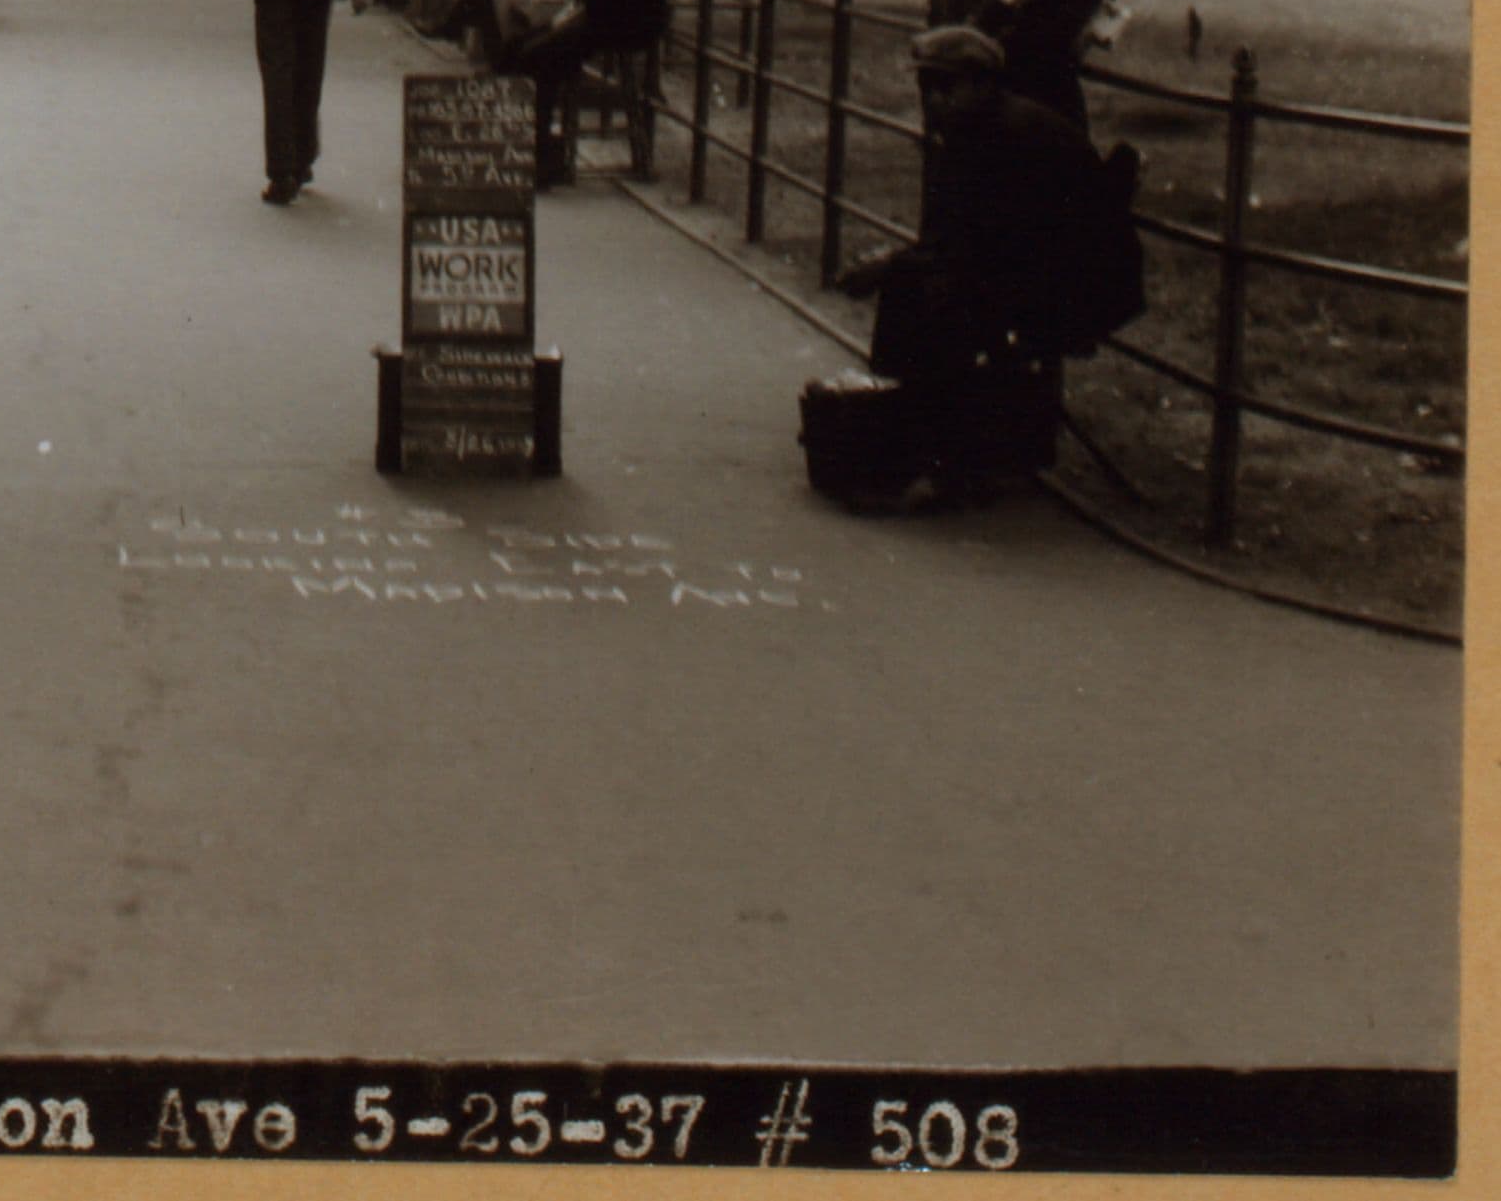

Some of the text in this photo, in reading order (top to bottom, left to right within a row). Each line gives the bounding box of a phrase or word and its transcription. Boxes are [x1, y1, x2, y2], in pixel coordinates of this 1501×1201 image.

[440, 216, 502, 246] USA
[418, 251, 518, 281] WORK
[439, 302, 503, 332] WPA
